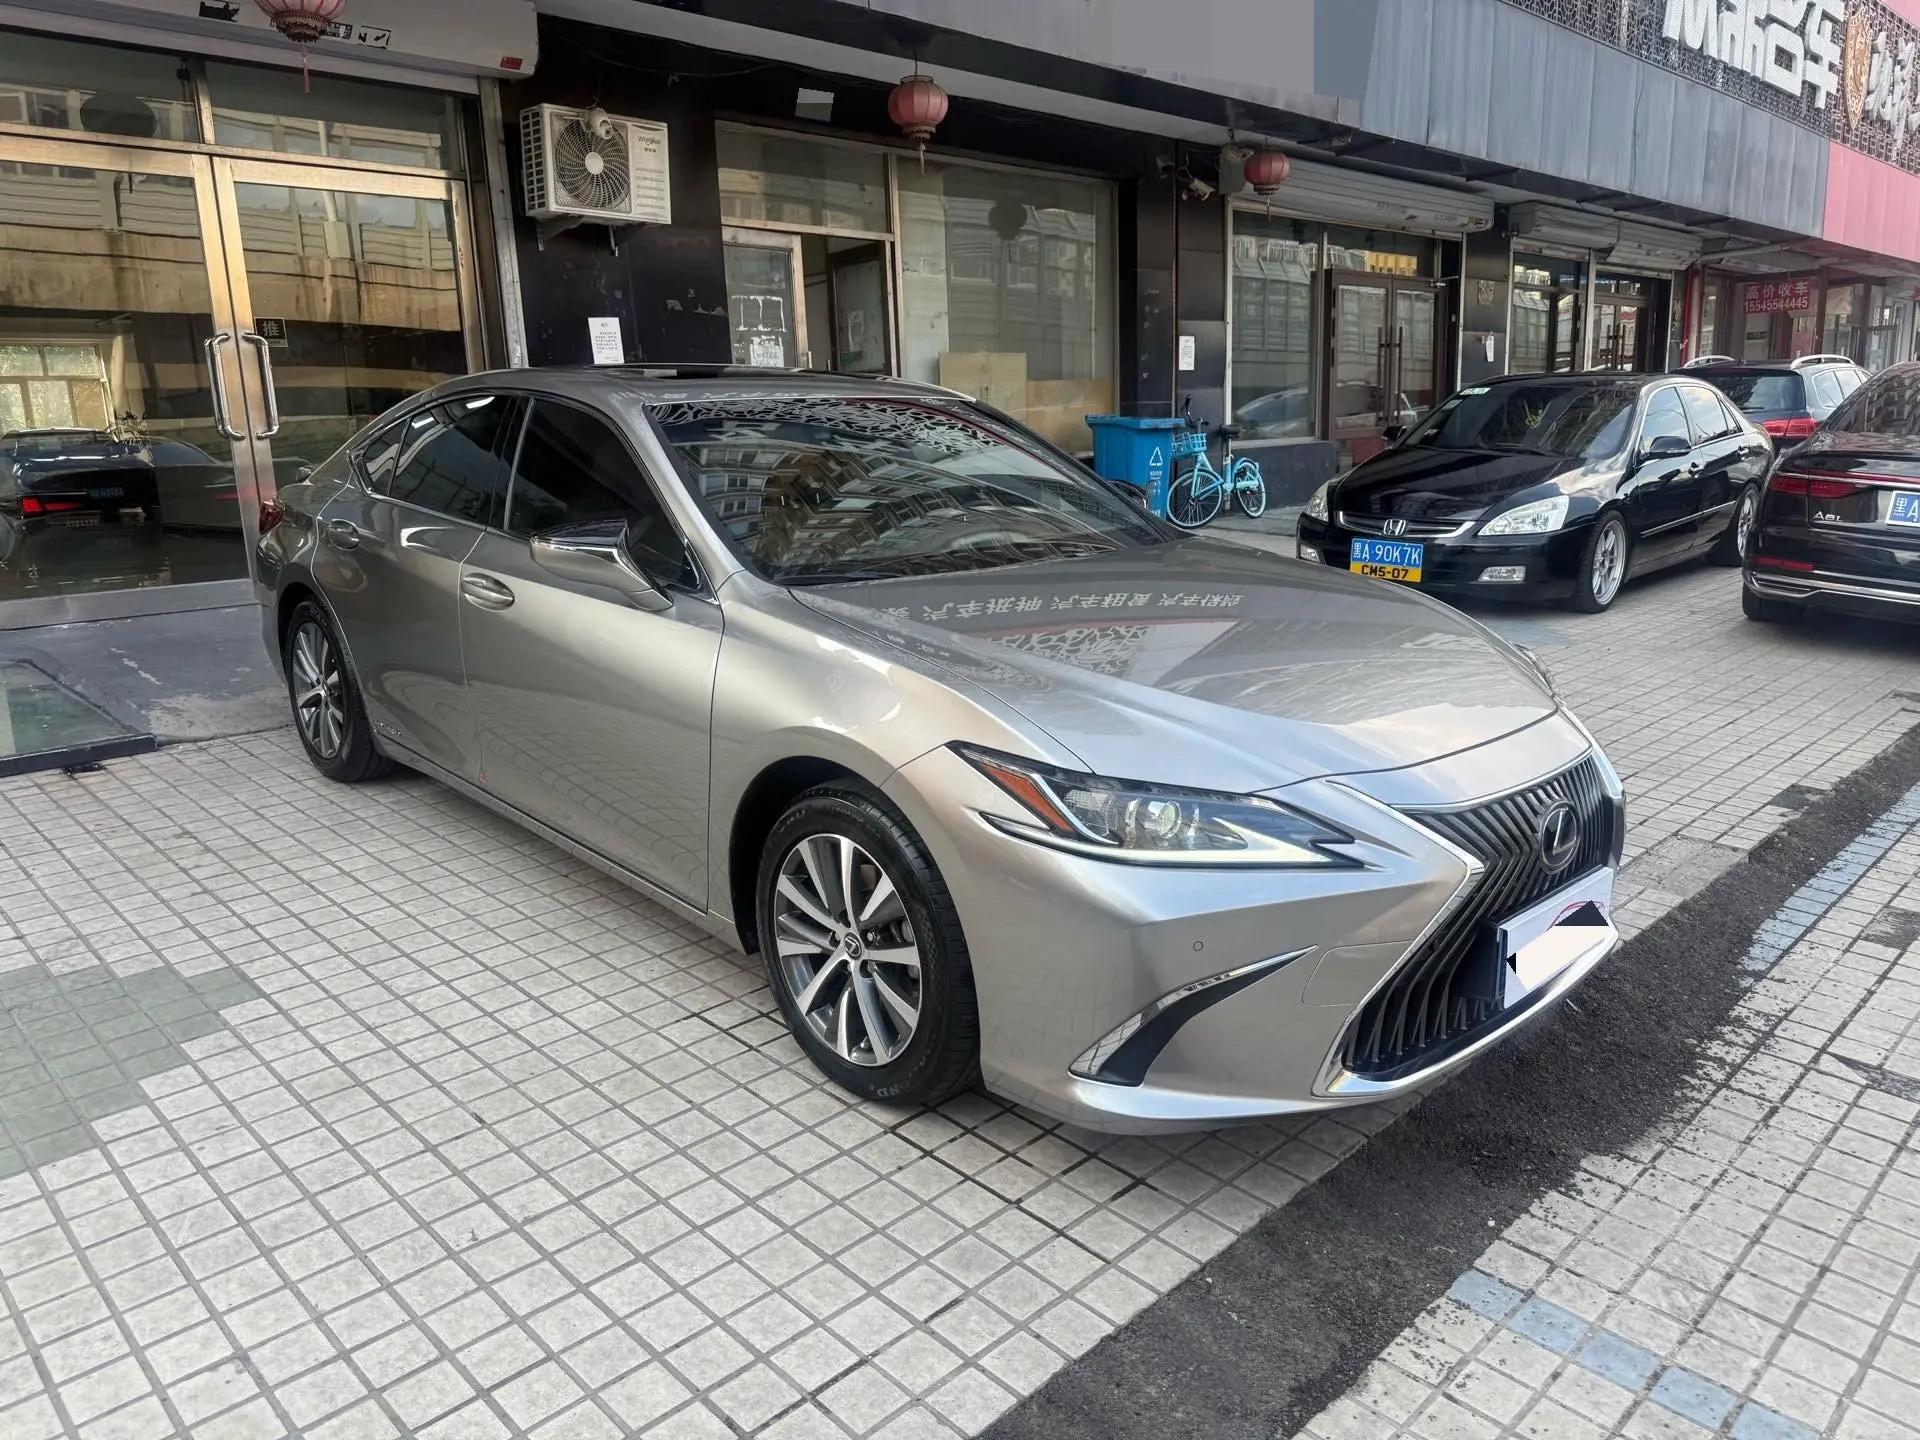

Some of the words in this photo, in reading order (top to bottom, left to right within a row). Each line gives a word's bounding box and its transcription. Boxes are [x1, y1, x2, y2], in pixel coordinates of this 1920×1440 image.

[1745, 280, 1808, 300] 高价收车
[262, 320, 280, 337] 推
[1812, 510, 1841, 521] A8L
